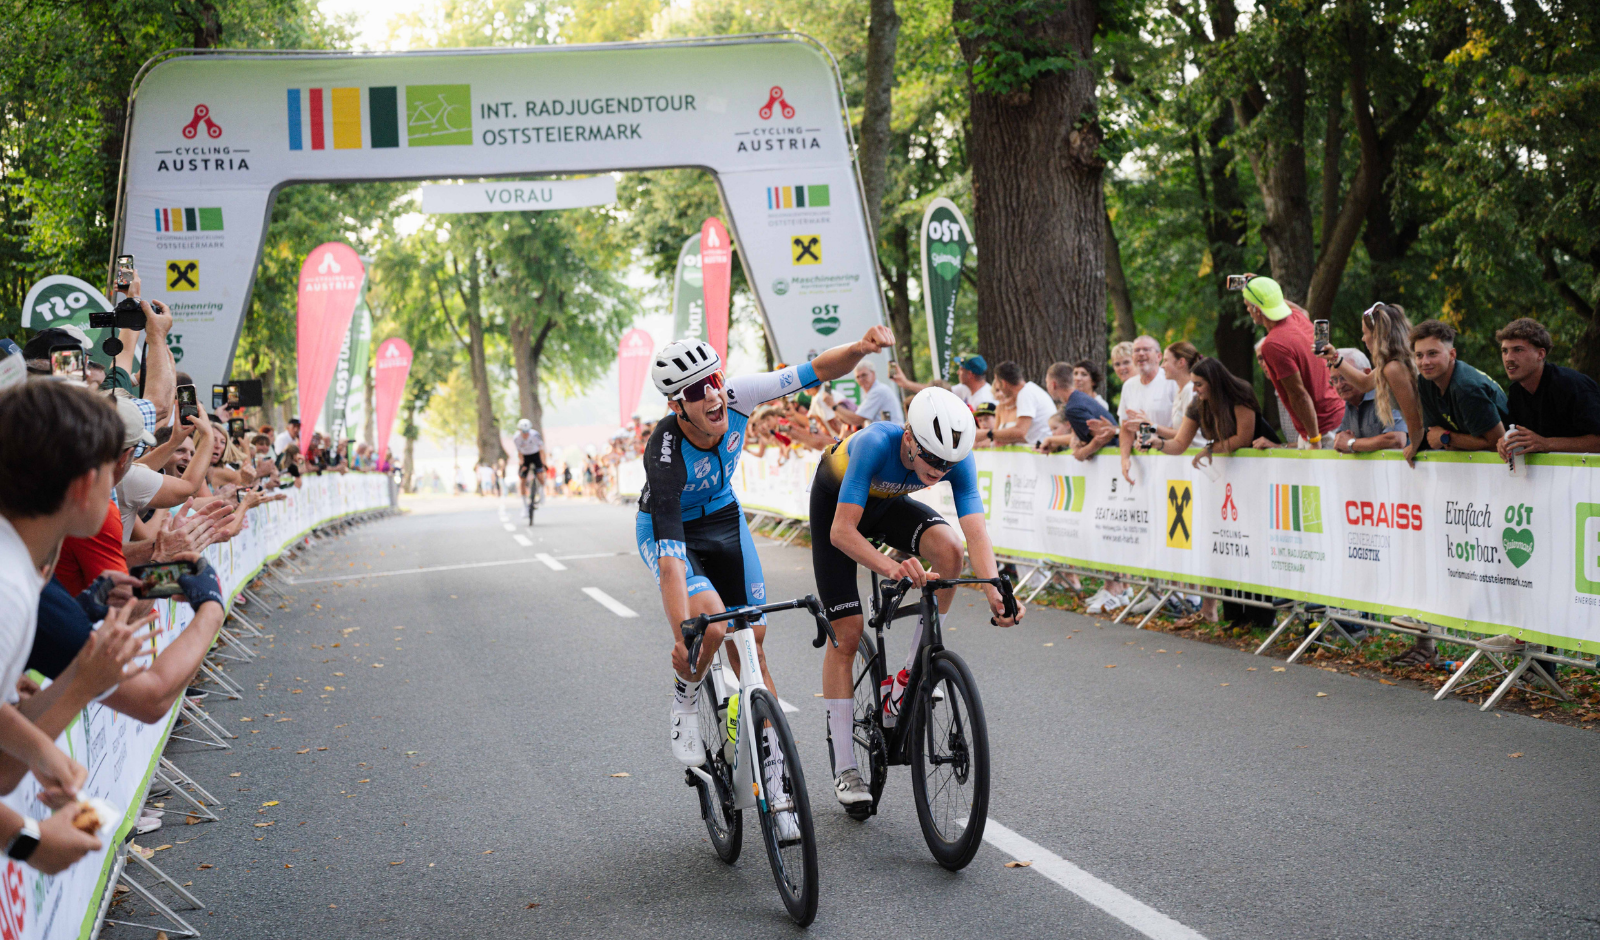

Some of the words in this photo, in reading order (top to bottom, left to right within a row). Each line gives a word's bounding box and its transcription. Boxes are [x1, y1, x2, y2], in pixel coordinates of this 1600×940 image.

[480, 101, 517, 120] INT.
[525, 95, 697, 117] RADJUGENDTOUR
[482, 123, 642, 146] OSTSTEIERMARK
[753, 127, 803, 136] CYCLING
[175, 147, 230, 156] CYCLING
[737, 137, 821, 153] AUSTRIA
[157, 158, 250, 172] AUSTRIA
[485, 188, 553, 204] VORAU
[929, 219, 960, 243] OST
[156, 241, 225, 250] OSTSTEIERMARK
[305, 280, 356, 292] AUSTRIA
[168, 302, 224, 311] chinenring
[811, 304, 839, 316] OST
[166, 333, 183, 346] ST
[1095, 507, 1110, 520] SEAT
[1110, 508, 1128, 522] HARB
[1129, 510, 1149, 524] WEIZ
[1345, 500, 1423, 531] CRAISS
[1445, 500, 1492, 534] Einfach
[1504, 503, 1534, 527] OST
[1219, 529, 1242, 540] CYCLING
[1348, 532, 1391, 549] GENERATION
[1212, 541, 1250, 559] AUSTRIA
[1348, 546, 1381, 562] LOGISTIK
[1503, 538, 1534, 556] Steiermark
[687, 581, 708, 592] owe
[1479, 573, 1533, 589] oststeiermark.com
[829, 600, 860, 613] VERGE
[1575, 596, 1597, 607] ENERGIE
